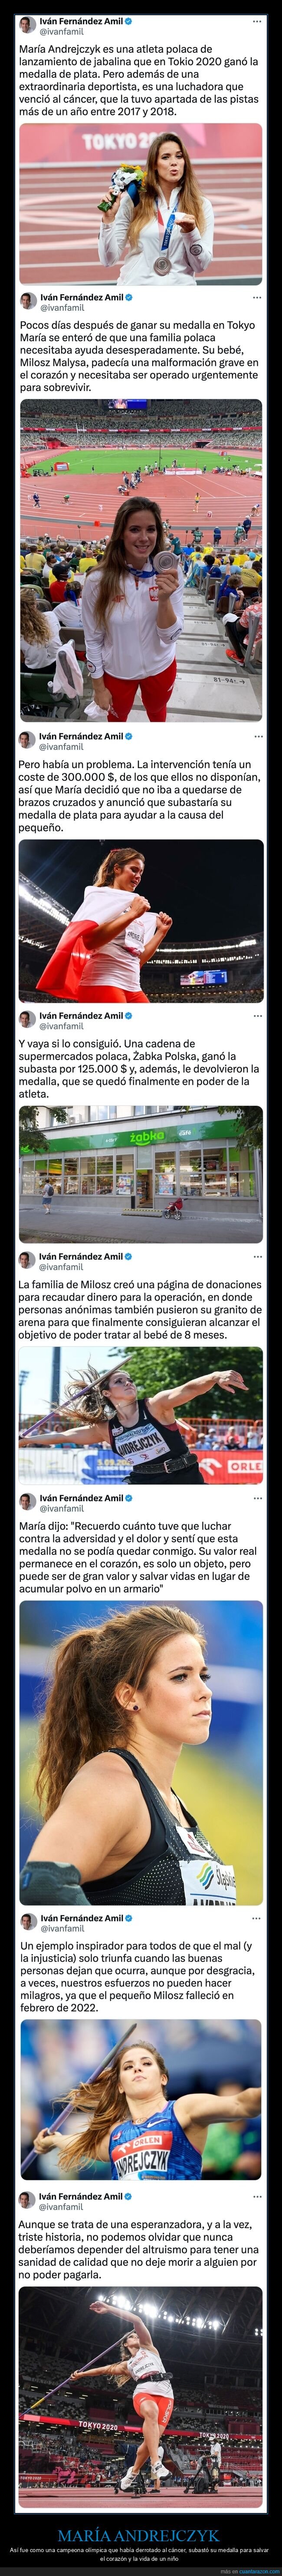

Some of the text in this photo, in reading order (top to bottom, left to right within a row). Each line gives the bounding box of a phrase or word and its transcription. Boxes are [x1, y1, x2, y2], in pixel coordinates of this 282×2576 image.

[82, 133, 137, 150] TOKYO
[130, 1131, 165, 1142] żabka
[118, 1432, 162, 1456] ANDREJCZYK
[134, 2137, 160, 2146] ORLEN
[116, 2151, 168, 2180] ANDREJCZYK
[134, 2362, 154, 2374] ANDREJCZYK
[161, 2399, 172, 2423] POLSKA
[79, 2420, 101, 2429] TOKYO
